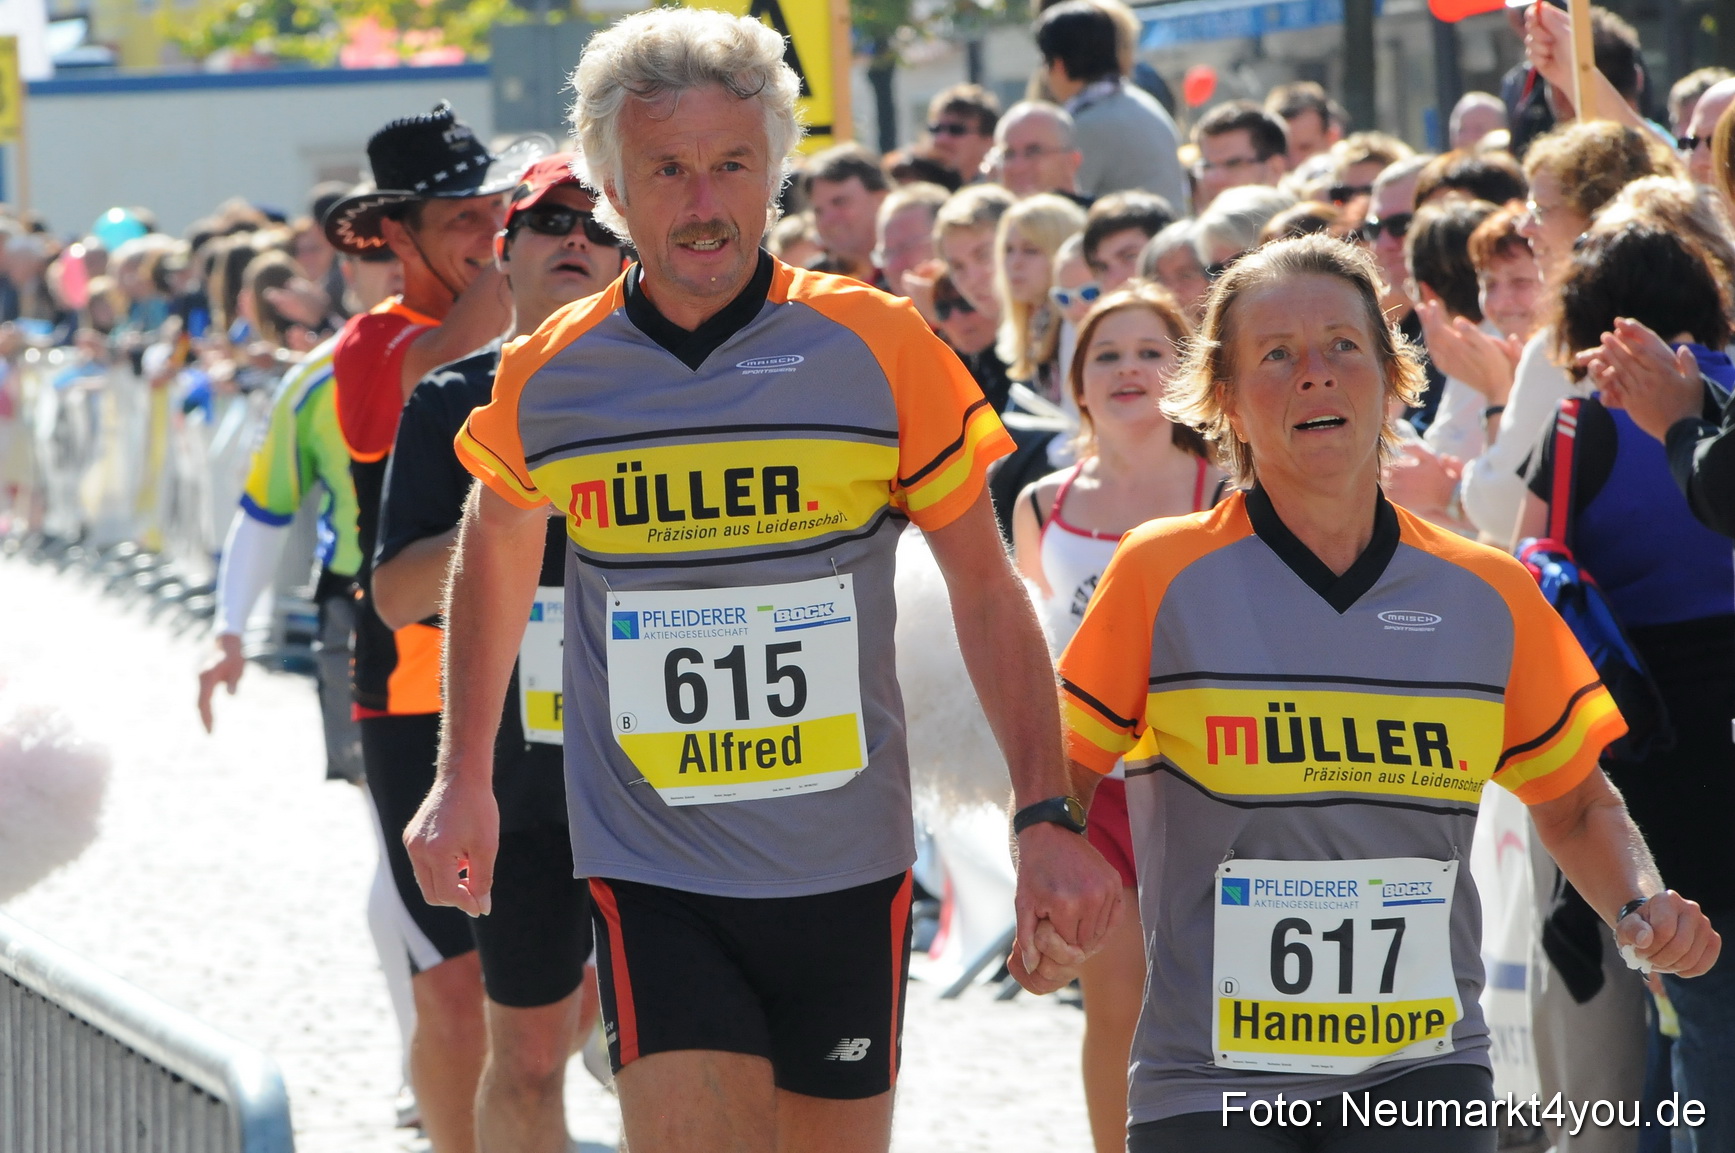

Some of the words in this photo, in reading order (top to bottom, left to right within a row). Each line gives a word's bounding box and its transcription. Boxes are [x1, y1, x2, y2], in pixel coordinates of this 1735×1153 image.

[647, 523, 717, 543] Präzision
[723, 522, 750, 537] aus
[643, 607, 747, 628] PFLEIDERER
[774, 602, 834, 623] BOCK
[1388, 614, 1433, 622] MAISCH
[644, 628, 749, 640] AKTIENGESELLSCHAFT
[664, 641, 807, 724] 615
[622, 716, 631, 730] B
[678, 725, 802, 774] Alfred
[1304, 767, 1372, 782] Präzision
[1378, 772, 1405, 784] aus
[1254, 879, 1359, 898] PFLEIDERER
[1382, 881, 1433, 898] BOCK
[1254, 899, 1360, 910] AKTIENGESELLSCHAFT
[1270, 917, 1406, 995] 617
[1224, 981, 1234, 994] D
[1233, 1001, 1445, 1045] Hannelore
